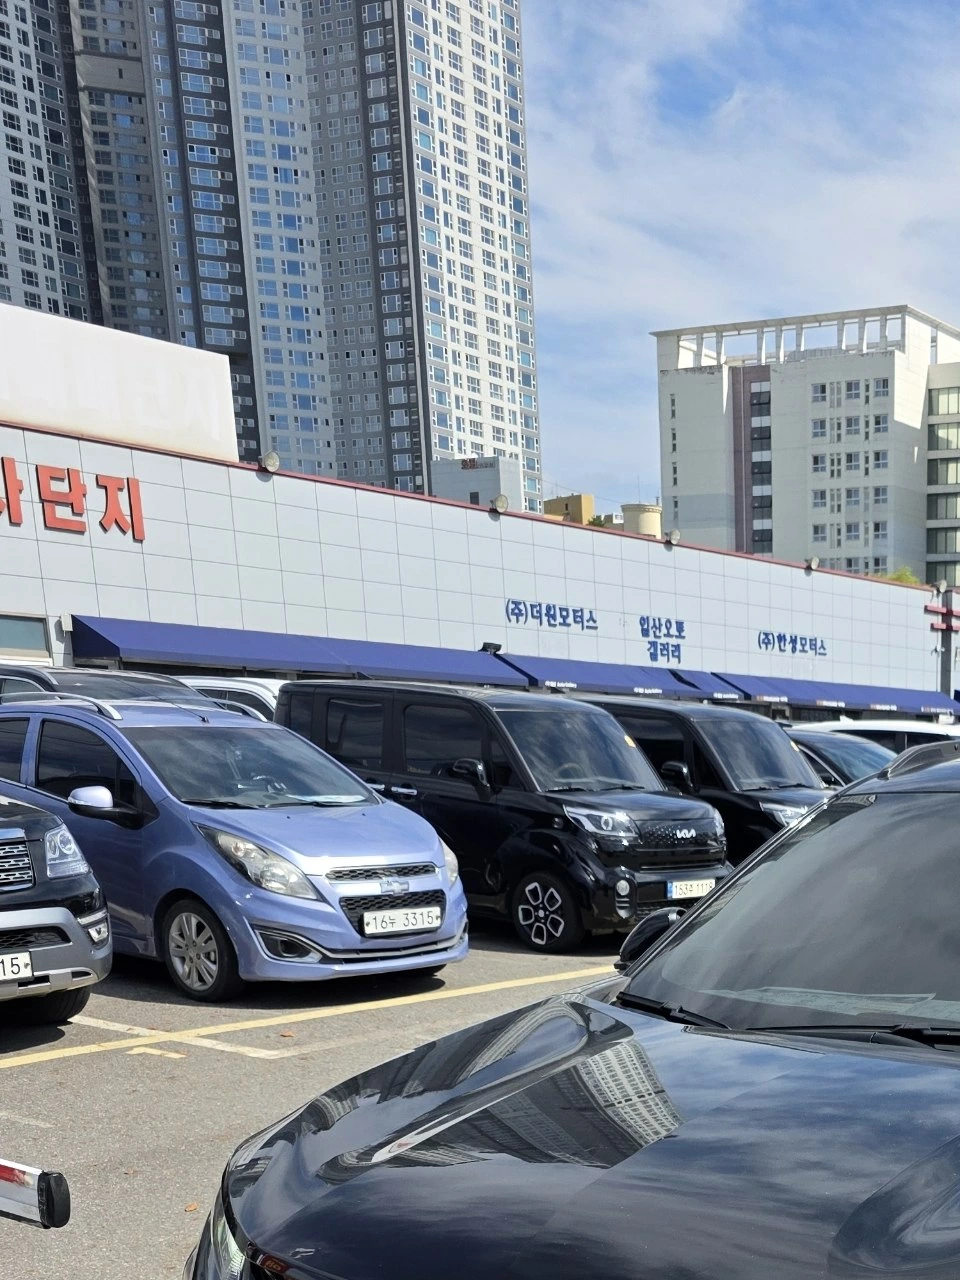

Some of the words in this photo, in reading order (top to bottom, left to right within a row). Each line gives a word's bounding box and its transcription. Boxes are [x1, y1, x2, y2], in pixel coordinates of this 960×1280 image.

[505, 599, 599, 631] (주)더원모터스
[638, 615, 686, 640] 일산오토
[647, 640, 682, 664] 갤러리
[372, 914, 397, 930] 16누
[402, 910, 434, 927] 3315
